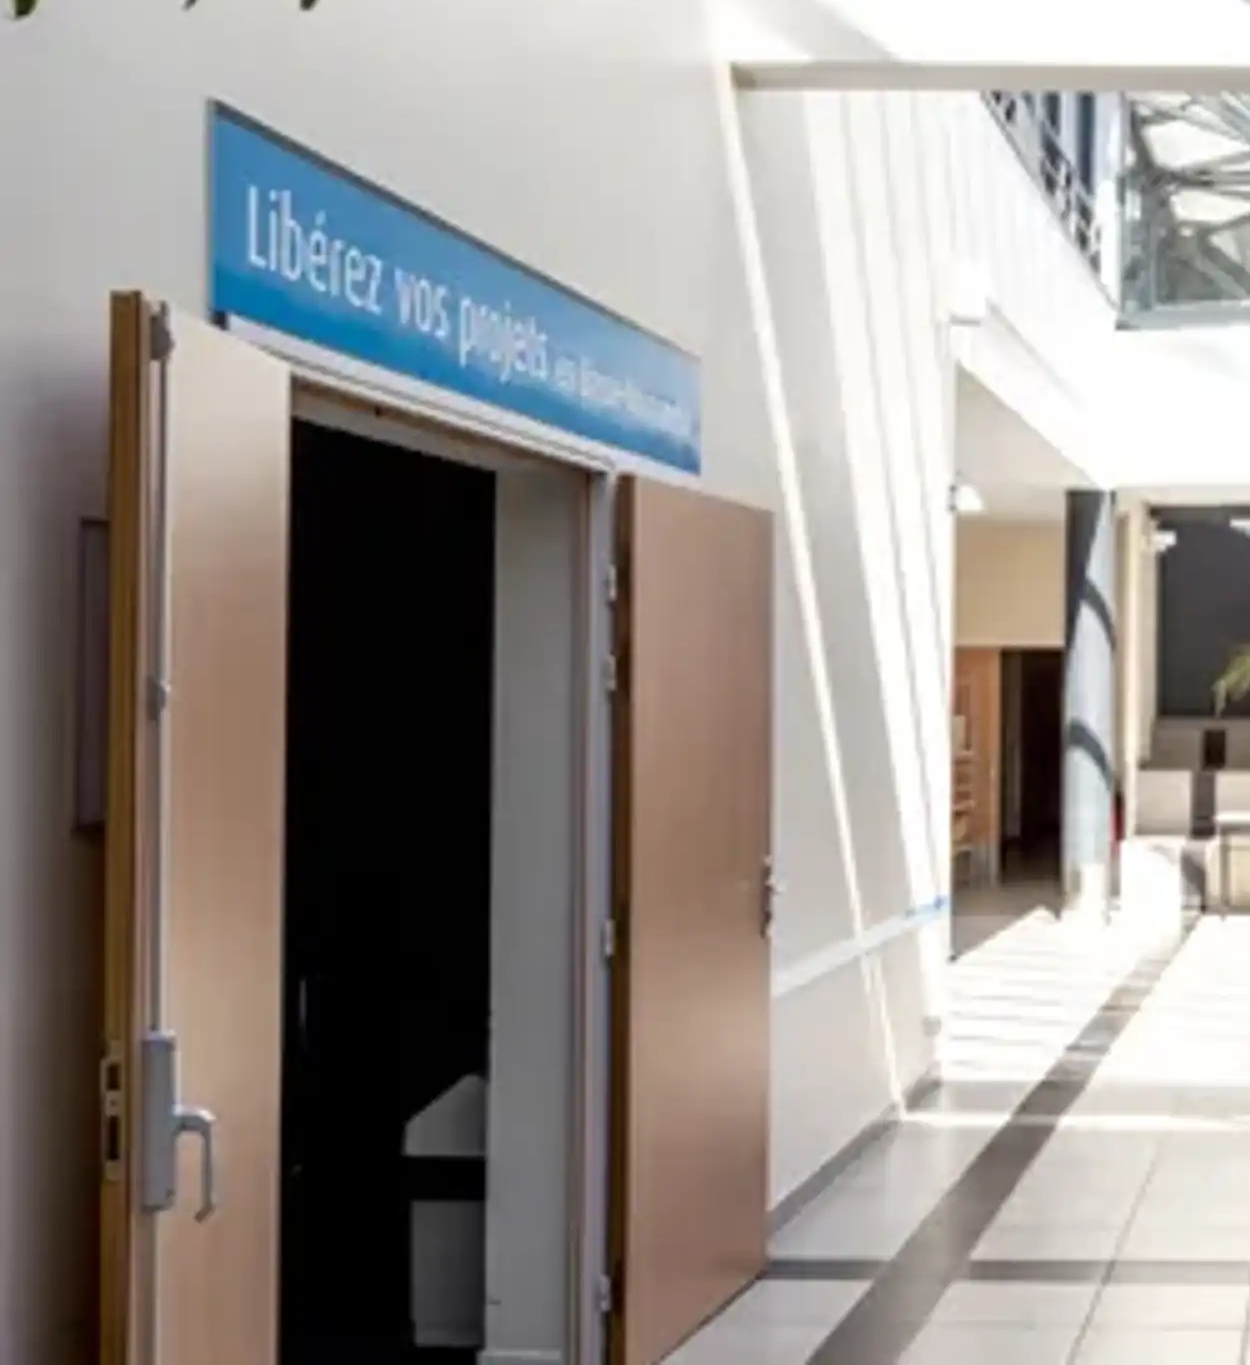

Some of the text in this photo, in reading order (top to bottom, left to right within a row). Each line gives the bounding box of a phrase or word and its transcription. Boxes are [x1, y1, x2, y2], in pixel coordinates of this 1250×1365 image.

[248, 184, 549, 384] Libérez vos projets
